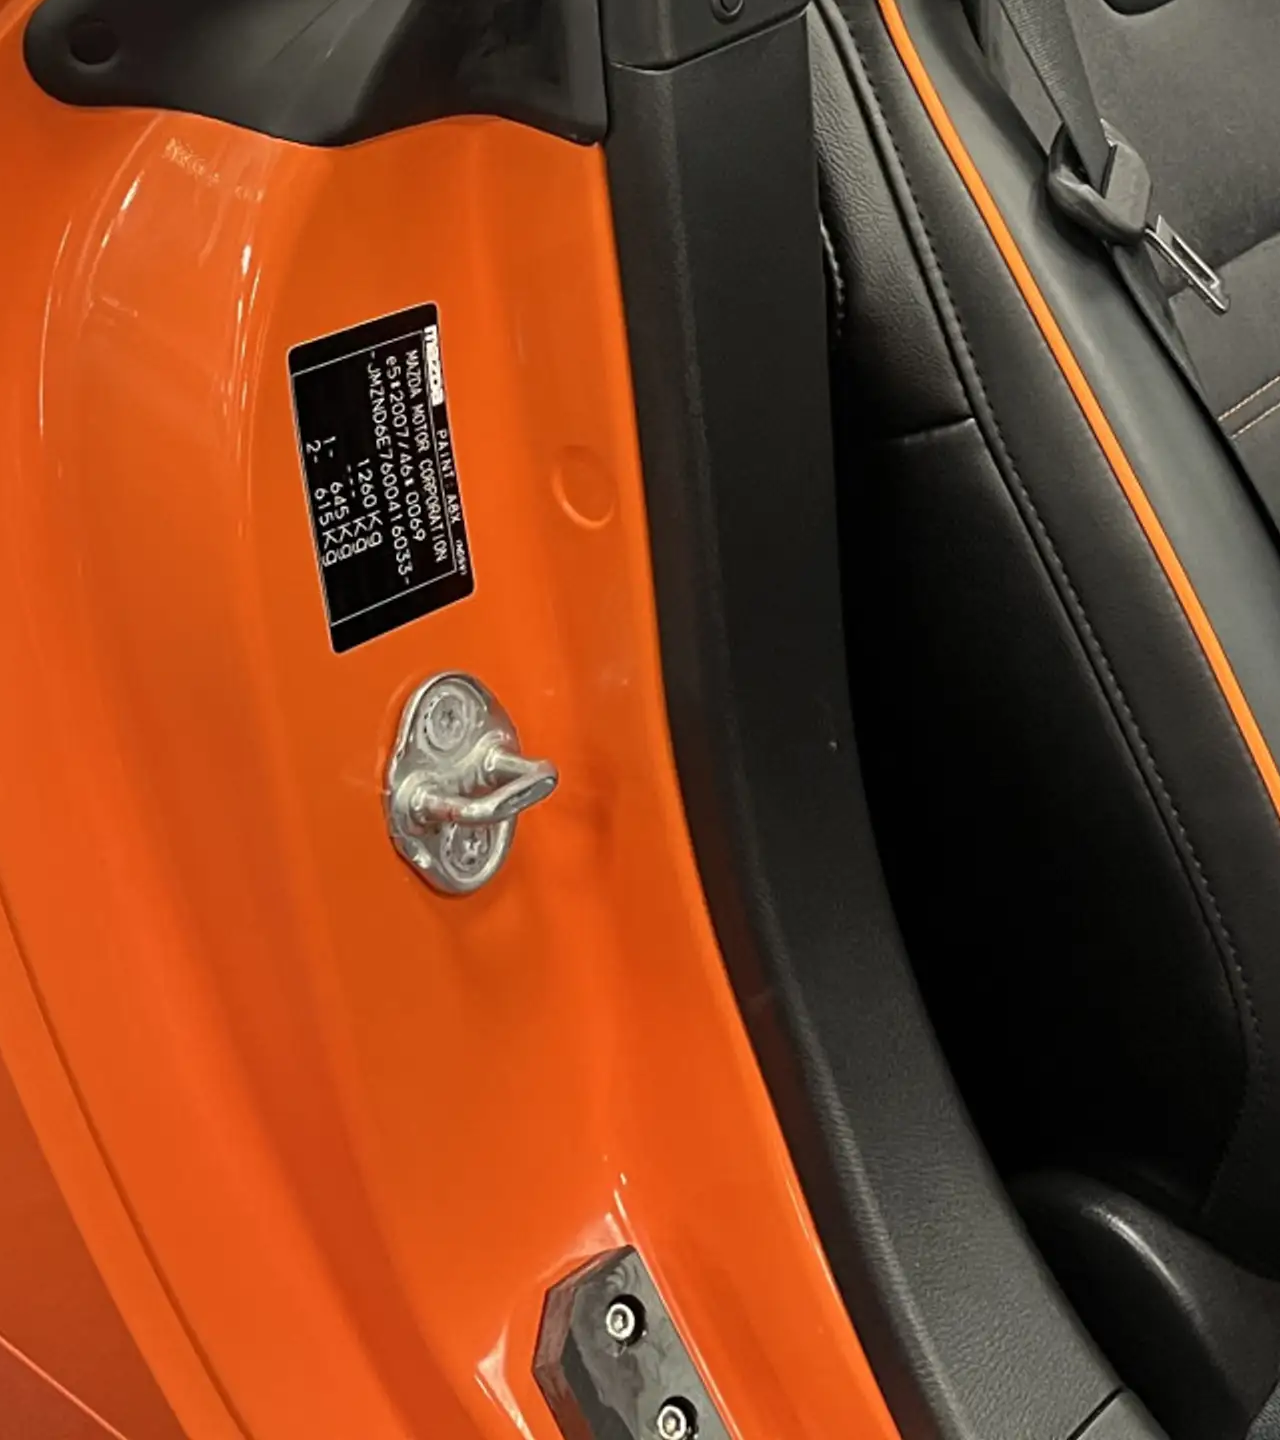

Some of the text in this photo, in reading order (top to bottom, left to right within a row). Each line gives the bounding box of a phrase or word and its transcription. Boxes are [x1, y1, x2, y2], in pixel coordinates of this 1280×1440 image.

[405, 349, 448, 563] MAZDA MOTOR CORPORATION
[314, 487, 335, 527] 615
[330, 481, 350, 520] 645
